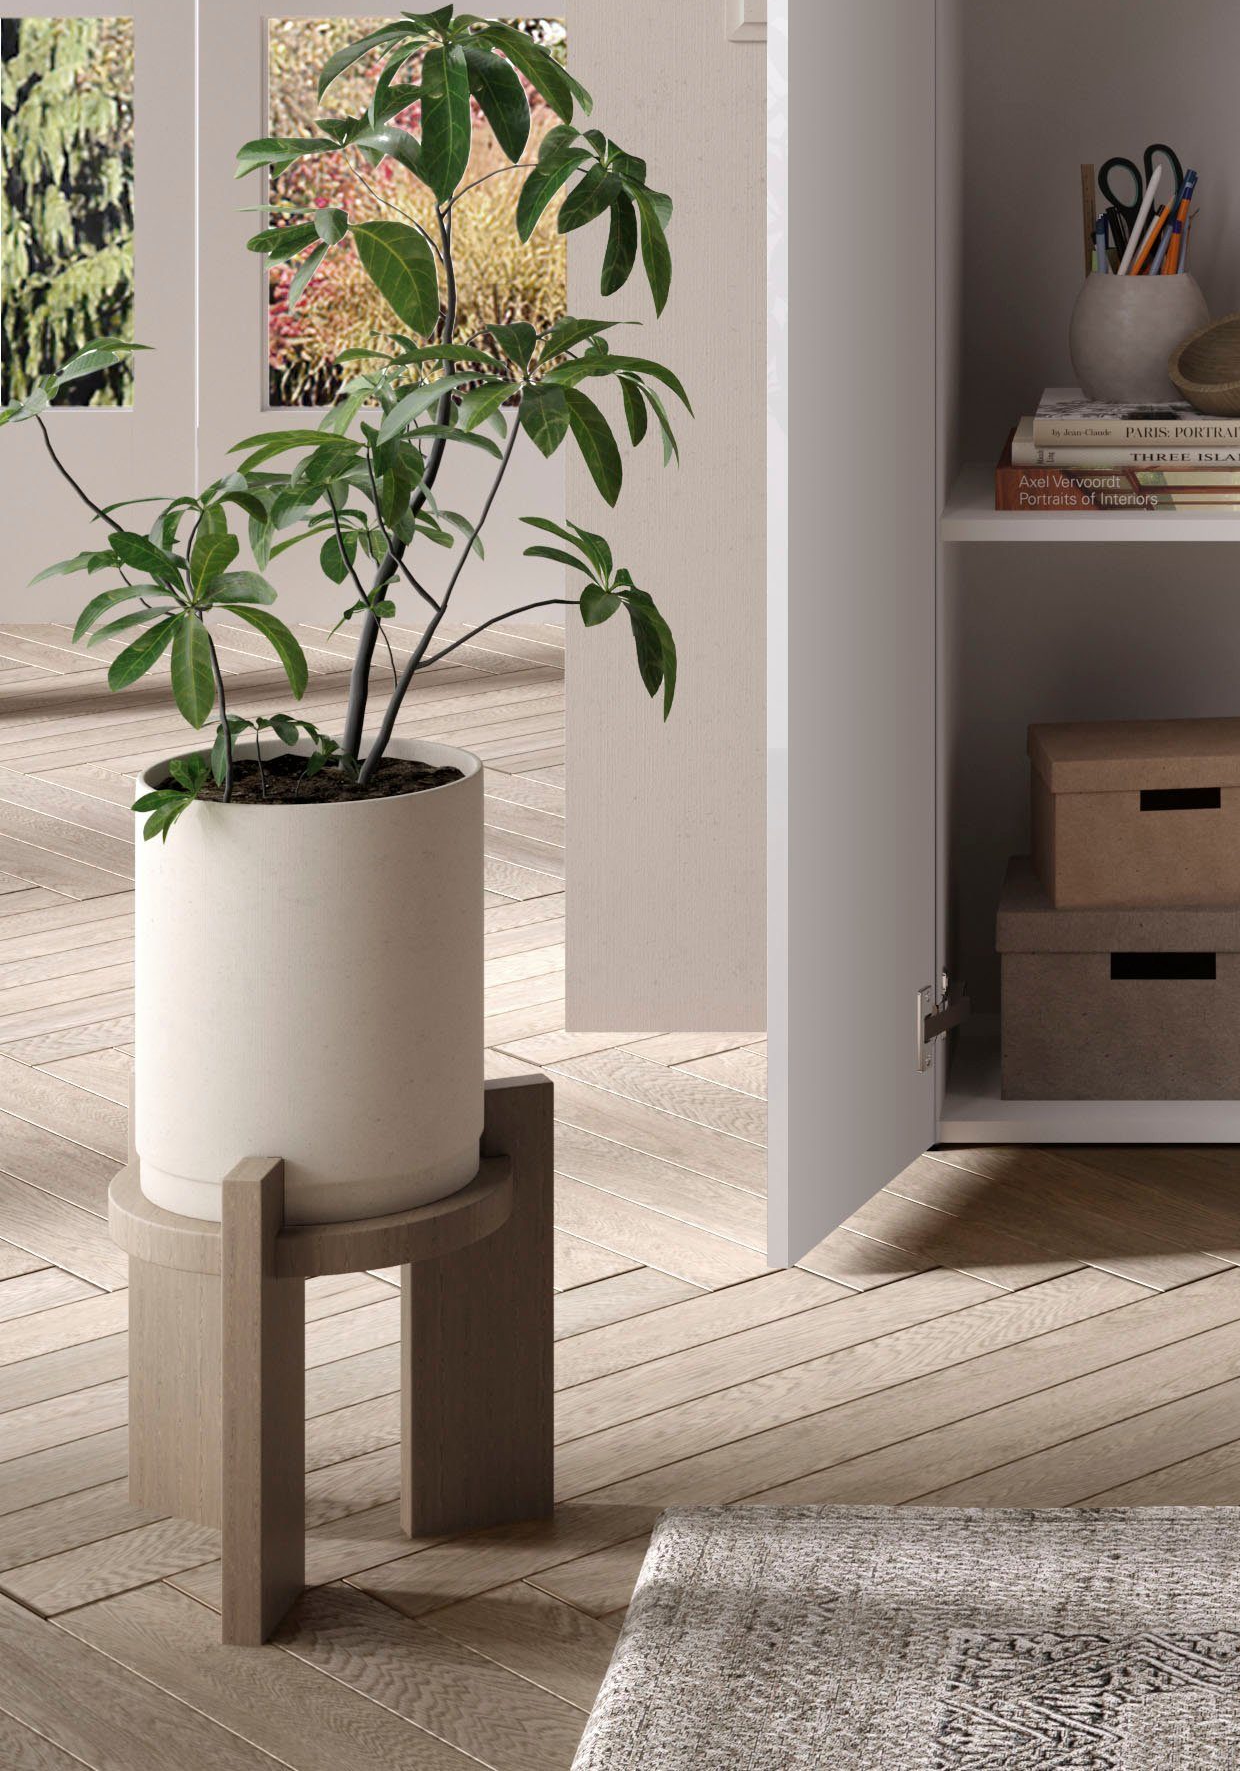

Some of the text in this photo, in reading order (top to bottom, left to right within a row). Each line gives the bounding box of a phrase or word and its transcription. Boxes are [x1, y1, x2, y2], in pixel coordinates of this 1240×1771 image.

[1063, 428, 1112, 436] Jean-Claude
[1126, 427, 1170, 438] PARIS:
[1130, 453, 1190, 462] THREE
[1018, 474, 1121, 488] Axel Vervoordt
[1020, 492, 1158, 506] Portraits of Interiors
